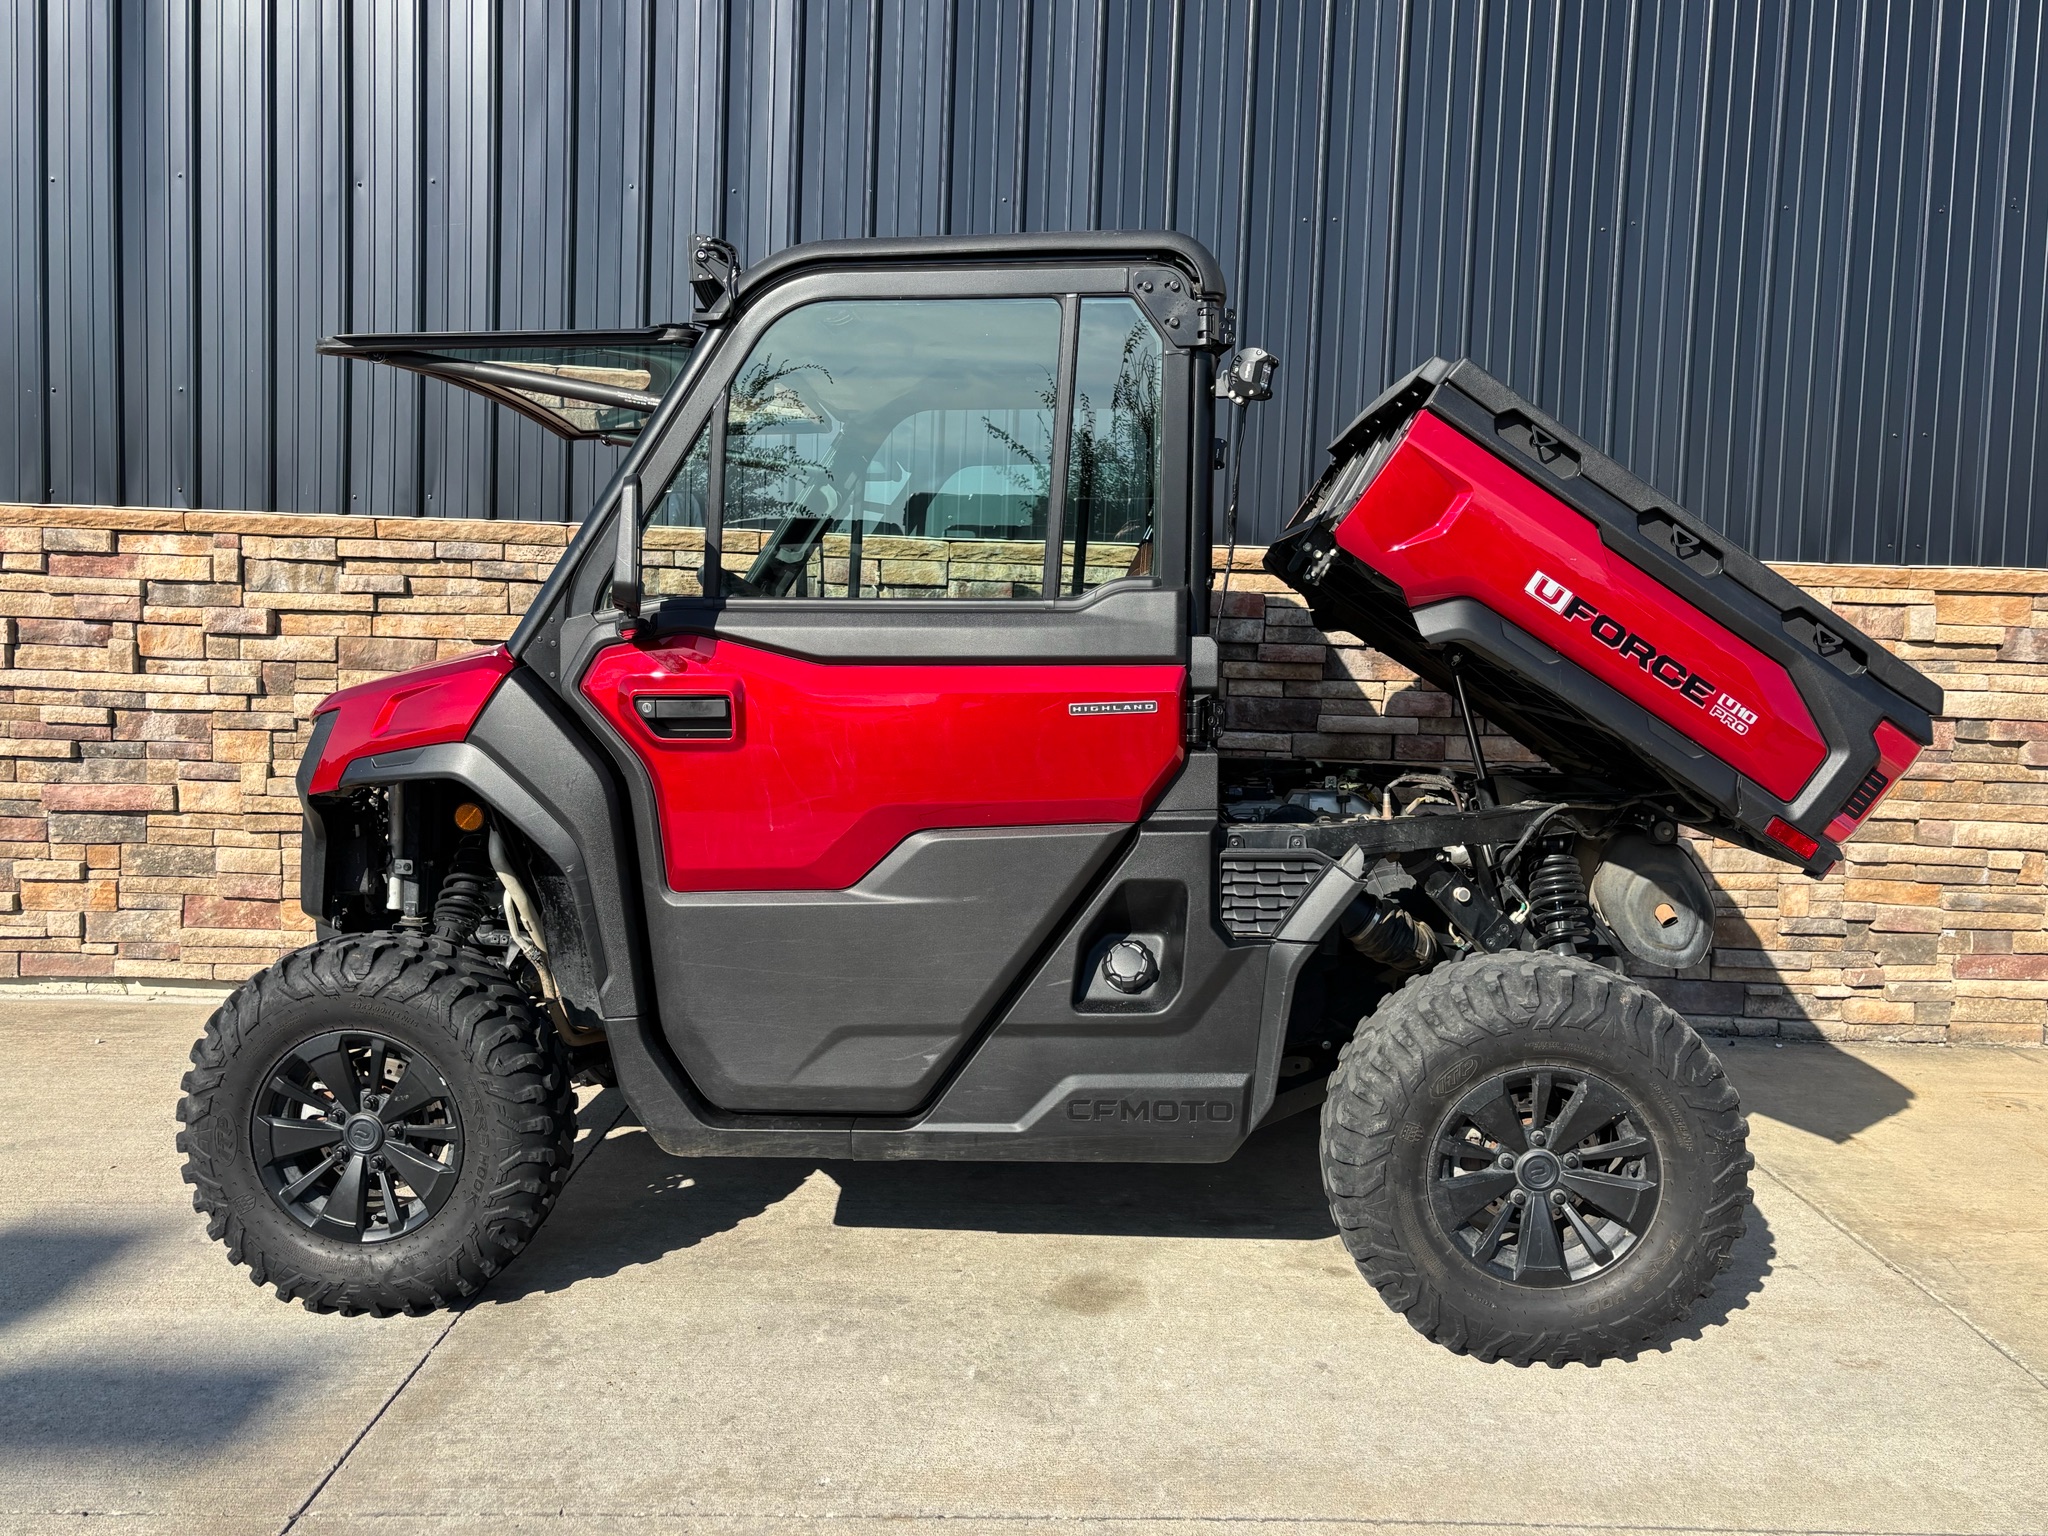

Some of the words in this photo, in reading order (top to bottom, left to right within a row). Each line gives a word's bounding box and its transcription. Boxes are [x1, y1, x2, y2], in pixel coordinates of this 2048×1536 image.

[1072, 703, 1154, 713] HIGHLAND
[1709, 705, 1749, 736] PRO
[1716, 693, 1759, 725] U10
[1436, 1058, 1479, 1096] ITP
[1066, 1100, 1234, 1123] CFMOTO
